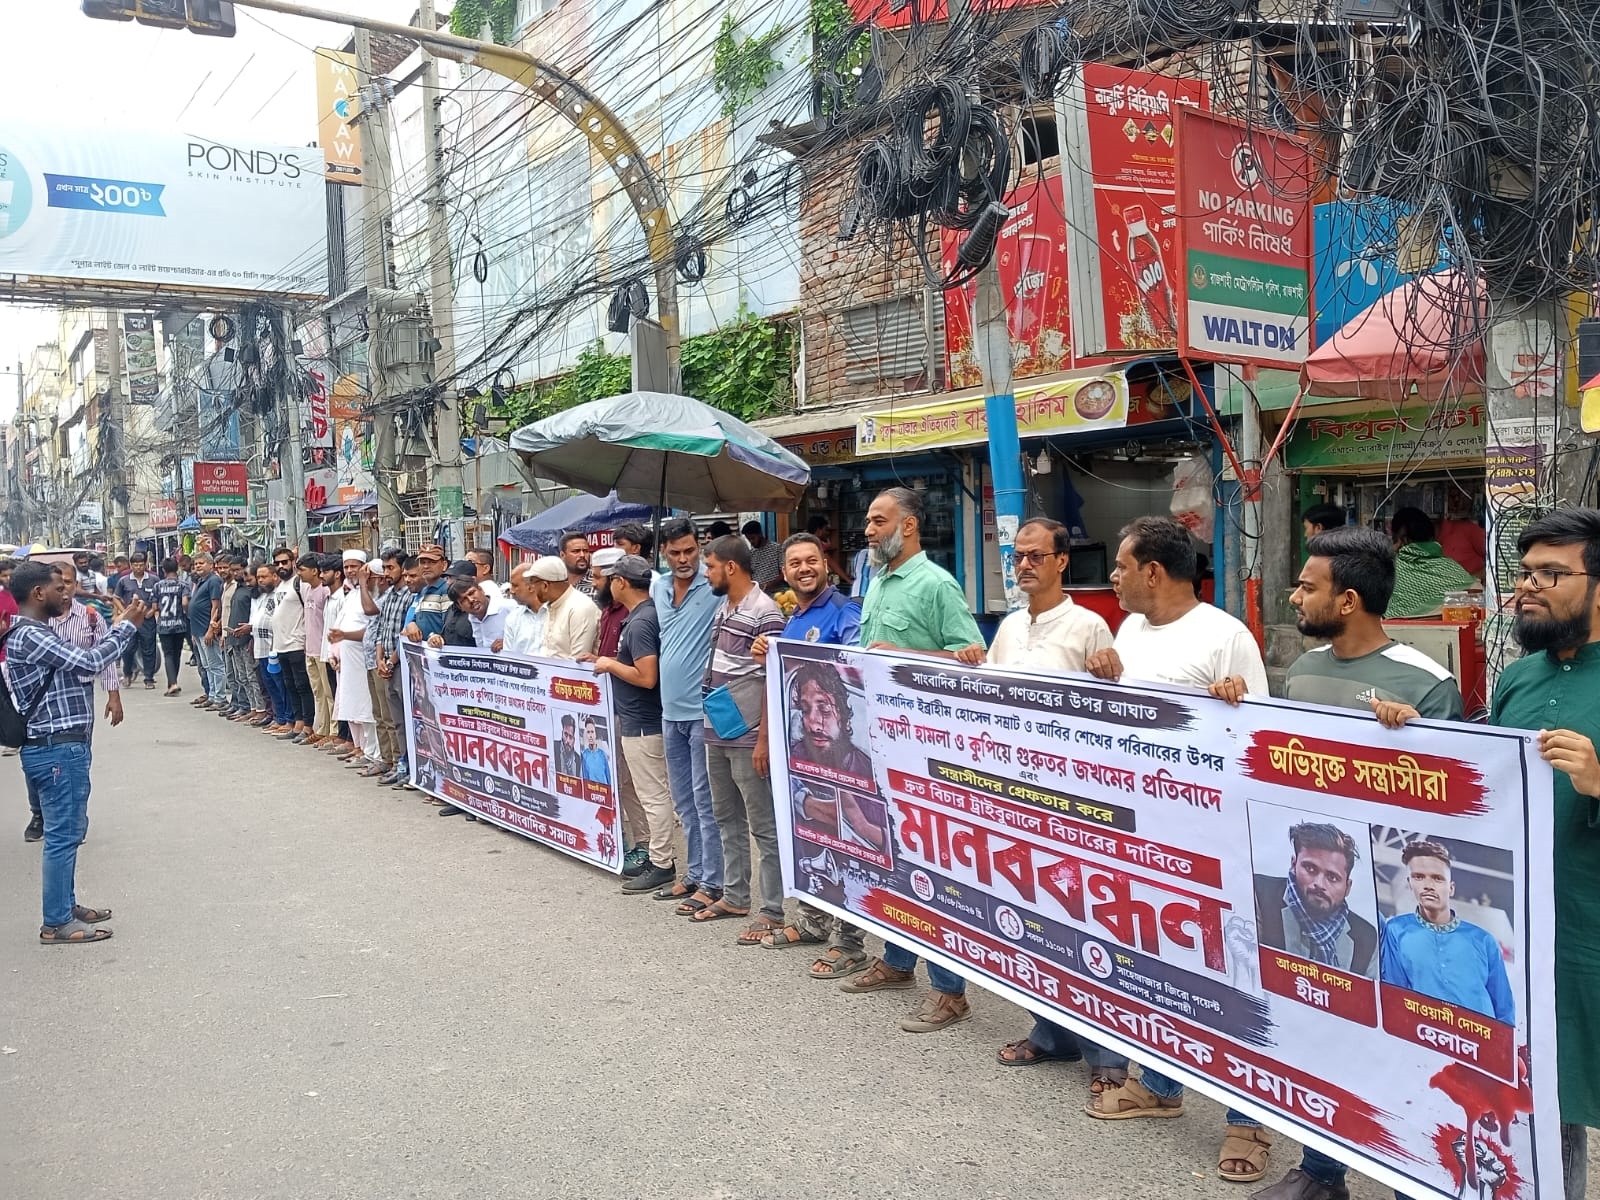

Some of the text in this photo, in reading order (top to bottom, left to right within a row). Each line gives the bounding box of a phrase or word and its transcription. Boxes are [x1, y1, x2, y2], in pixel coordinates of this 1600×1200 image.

[187, 142, 301, 179] POND'S
[188, 170, 301, 189] SKIN INSTITUTE
[1199, 189, 1294, 227] NO PARKING
[1203, 218, 1292, 257] পার্কিং নিষেধ
[1210, 271, 1232, 287] রাজশাহী
[1282, 282, 1304, 301] রাজশাহী
[1203, 315, 1295, 351] WALTON
[1016, 391, 1069, 425] হালিম
[161, 595, 177, 617] 24
[912, 672, 1158, 721] সাংবাদিক নির্যাতন, গণতন্ত্রের উপর আঘাত
[876, 692, 1225, 771] সাংবাদিক ইব্রাহীম হোসেন সম্রাট ও আবির শেখের পরিবারের উপর
[444, 730, 549, 788] মানববন্ধন
[878, 715, 1222, 812] সন্ত্রাসী হামলা ও কুপিয়ে গুরুতর জখমের প্রতিবাদে
[1019, 770, 1039, 782] এবং
[1268, 738, 1448, 802] অভিযুক্ত সন্ত্রাসীরা
[937, 766, 1113, 822] সন্ত্রাসীদের গ্রেফতার করে
[467, 794, 506, 819] রাজশাহীর
[508, 809, 547, 834] সাংবাদিক
[549, 825, 577, 847] সমাজ
[904, 779, 1192, 875] দ্রুত বিচার ট্রাইবুনালে বিচারের দাবিতে
[895, 798, 1232, 975] মানববন্ধন
[1275, 957, 1353, 992] আওয়ামী দোসর
[1294, 977, 1330, 1009] হীরা
[882, 903, 1340, 1127] আয়োজনে: রাজশাহীর সাংবাদিক সমাজ
[1155, 993, 1197, 1017] রাজশাহী।
[1164, 982, 1190, 1001] জিরো
[1192, 995, 1224, 1015] পয়েন্ট,
[1403, 997, 1492, 1040] আওয়ামী দোসর
[1416, 1023, 1479, 1061] হেলাল
